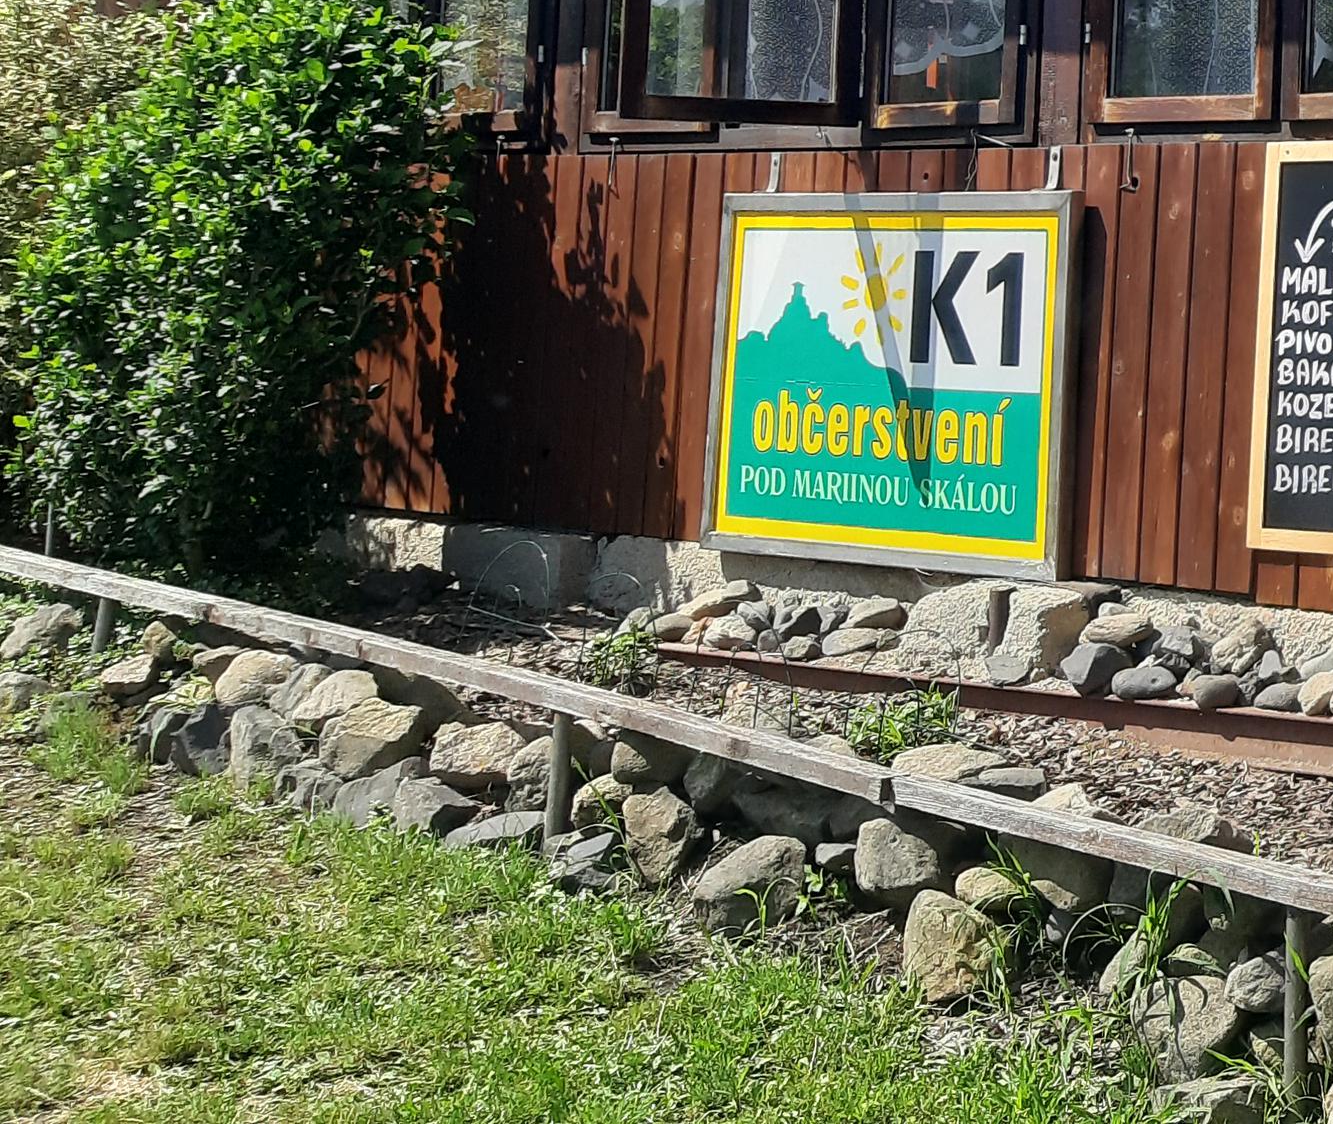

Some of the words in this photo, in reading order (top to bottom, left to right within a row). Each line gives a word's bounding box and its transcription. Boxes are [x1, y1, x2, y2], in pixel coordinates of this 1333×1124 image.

[909, 250, 1026, 366] K1
[753, 387, 1012, 467] občerstvení
[740, 464, 786, 497] POD
[791, 469, 909, 507] MARIINOU
[919, 473, 1017, 515] SKÁLOU
